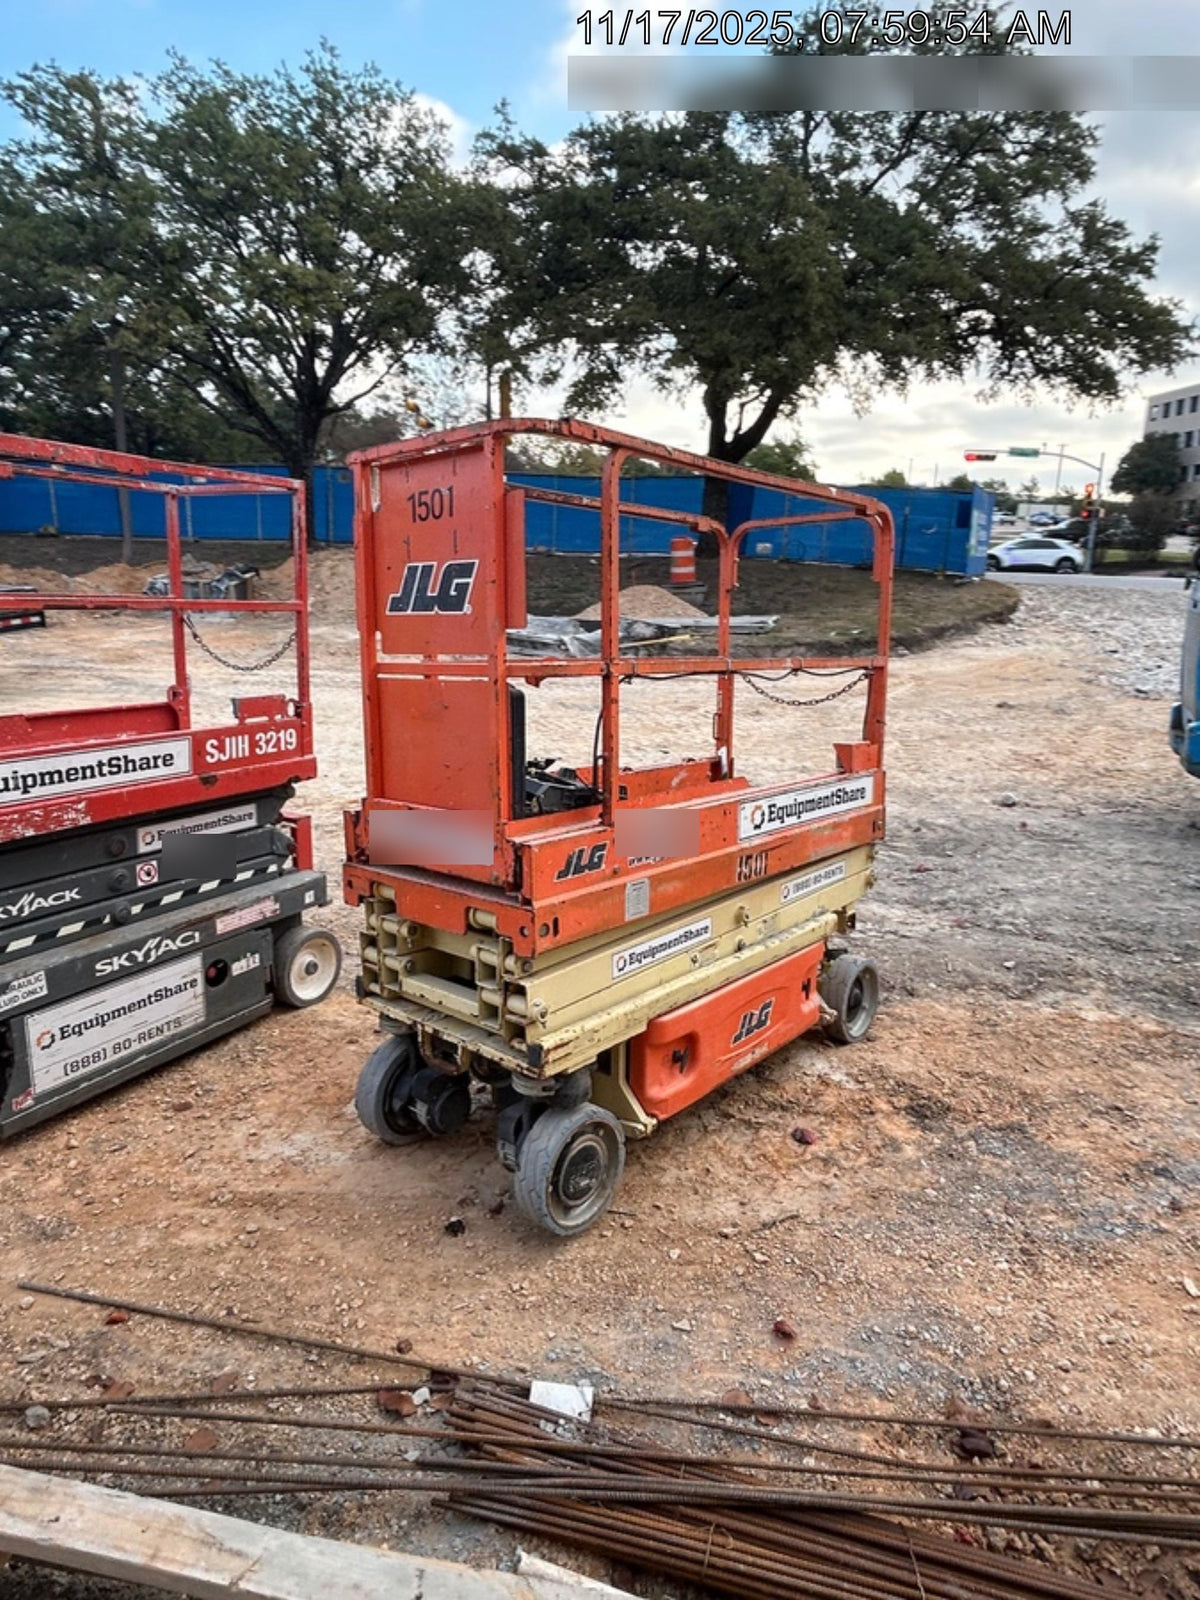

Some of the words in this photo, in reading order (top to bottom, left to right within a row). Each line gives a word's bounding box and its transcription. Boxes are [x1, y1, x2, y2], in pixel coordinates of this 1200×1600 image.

[407, 485, 454, 523] 1501
[386, 559, 479, 615] JLG
[205, 733, 250, 764] SJIH
[255, 729, 297, 755] 3219
[767, 786, 866, 824] EquipmentShare
[555, 843, 608, 882] JLG
[737, 852, 769, 882] 1501
[628, 925, 709, 966] EquipmentShare
[59, 976, 199, 1041] EquipmentShare
[730, 997, 776, 1047] JLG
[63, 1048, 108, 1077] (888)
[112, 1017, 182, 1056] 80-RENTS
